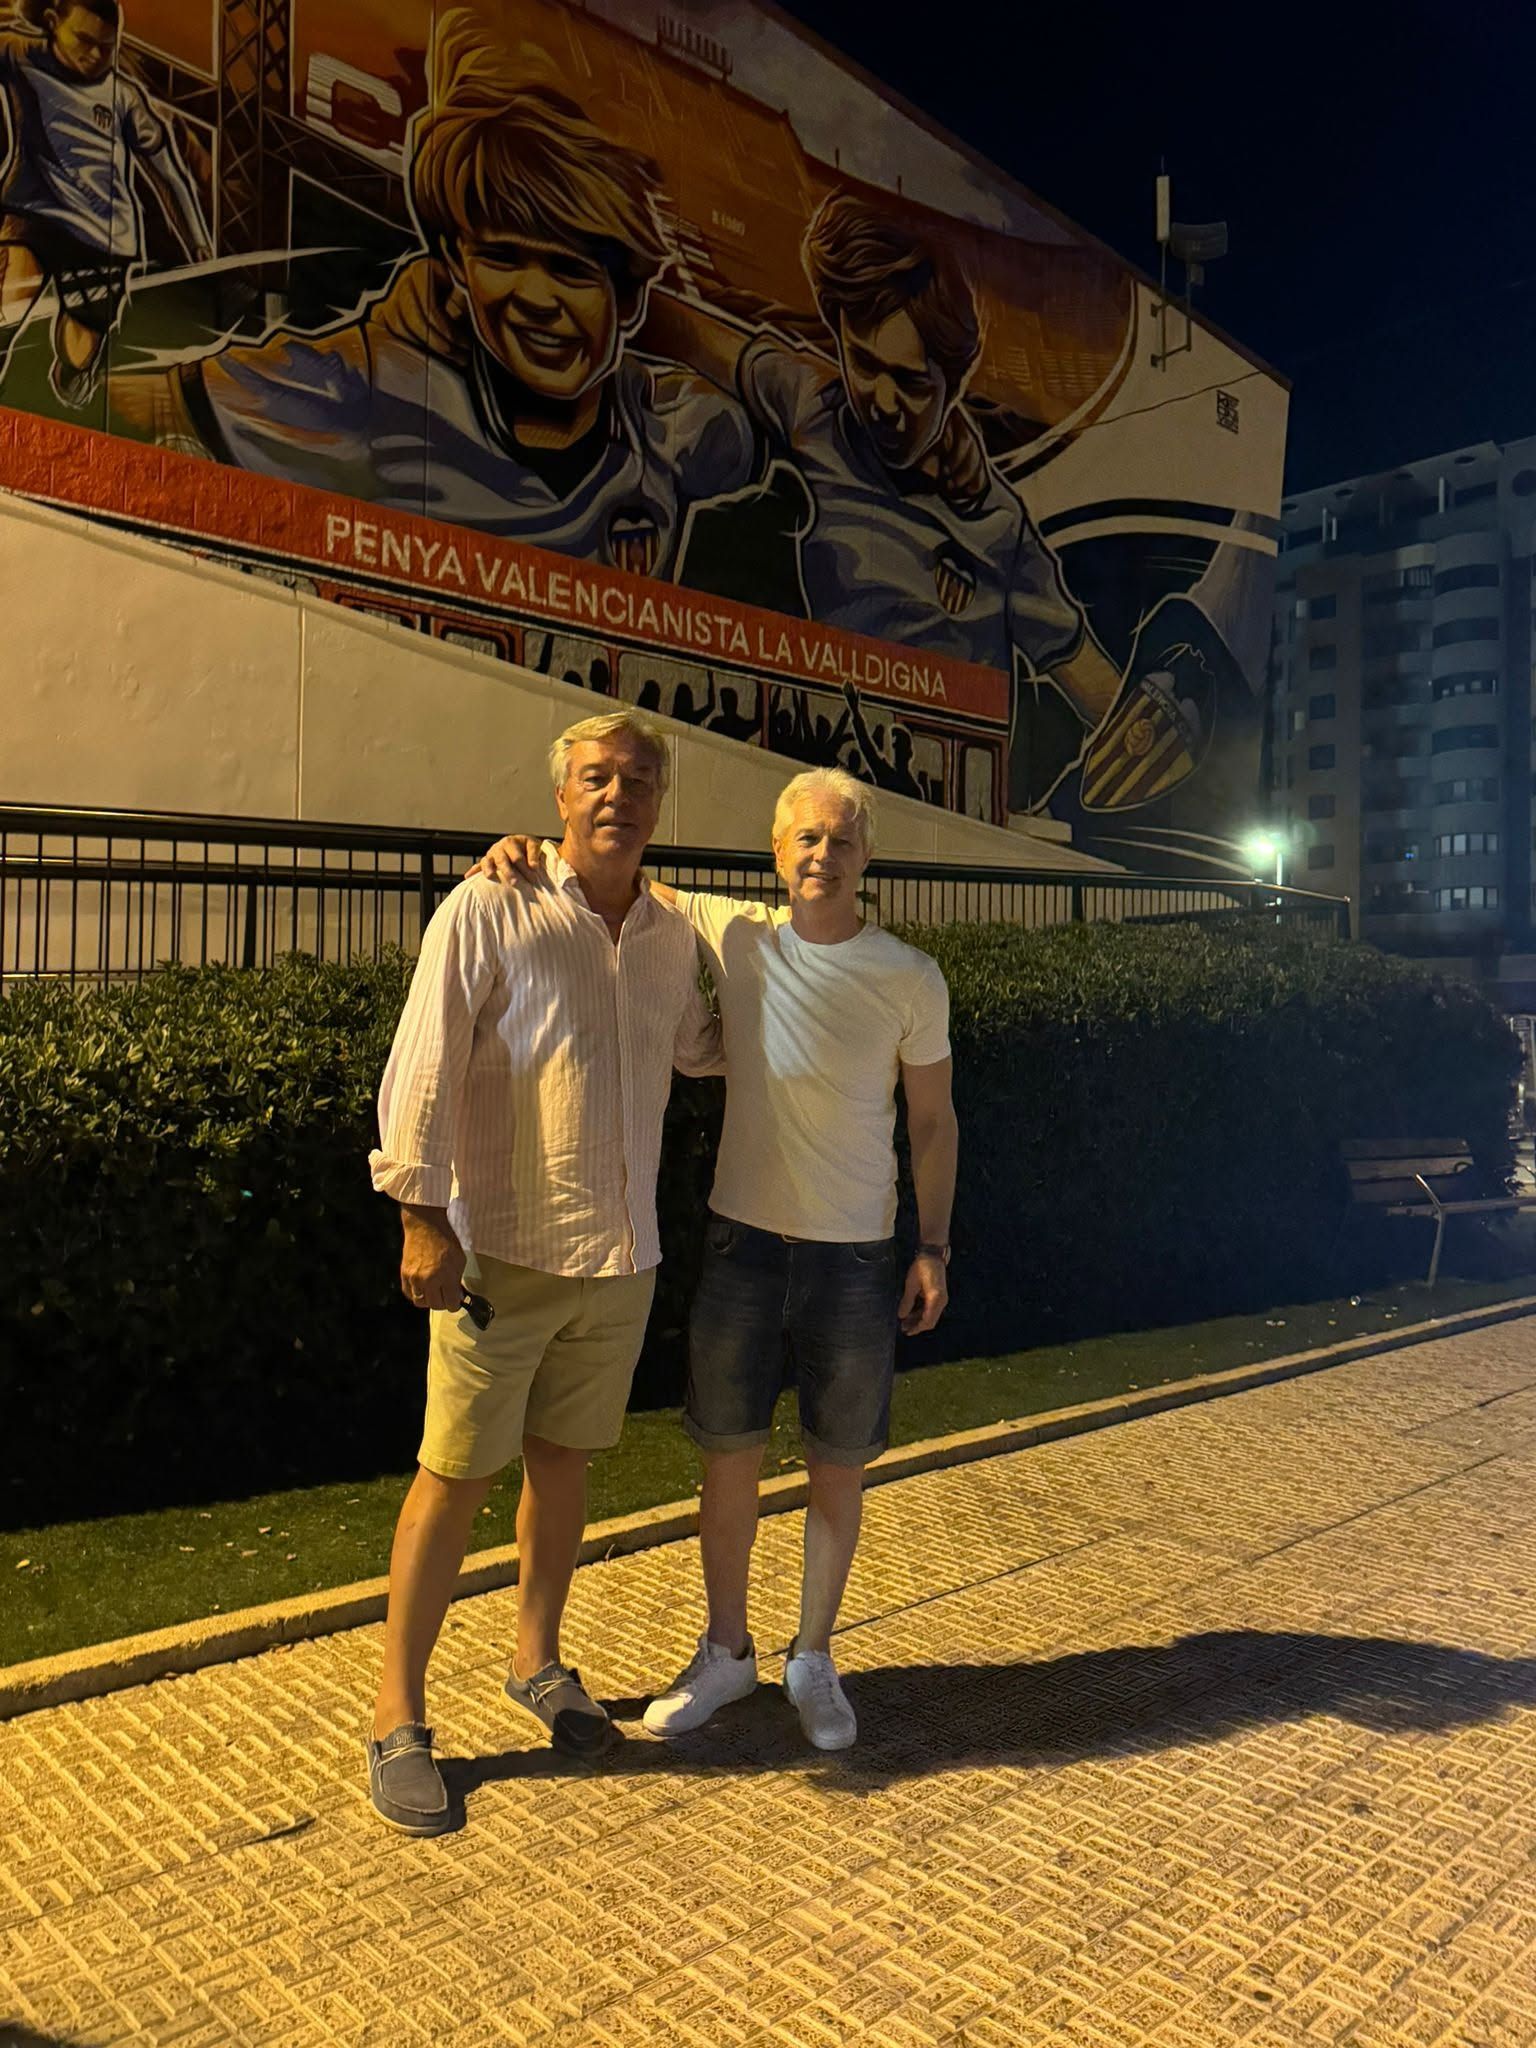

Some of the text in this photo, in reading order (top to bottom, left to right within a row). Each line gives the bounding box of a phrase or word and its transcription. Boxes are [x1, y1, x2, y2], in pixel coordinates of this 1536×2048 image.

[325, 513, 947, 700] PENYA VALENCIANISTA LA VALLDIGNA
